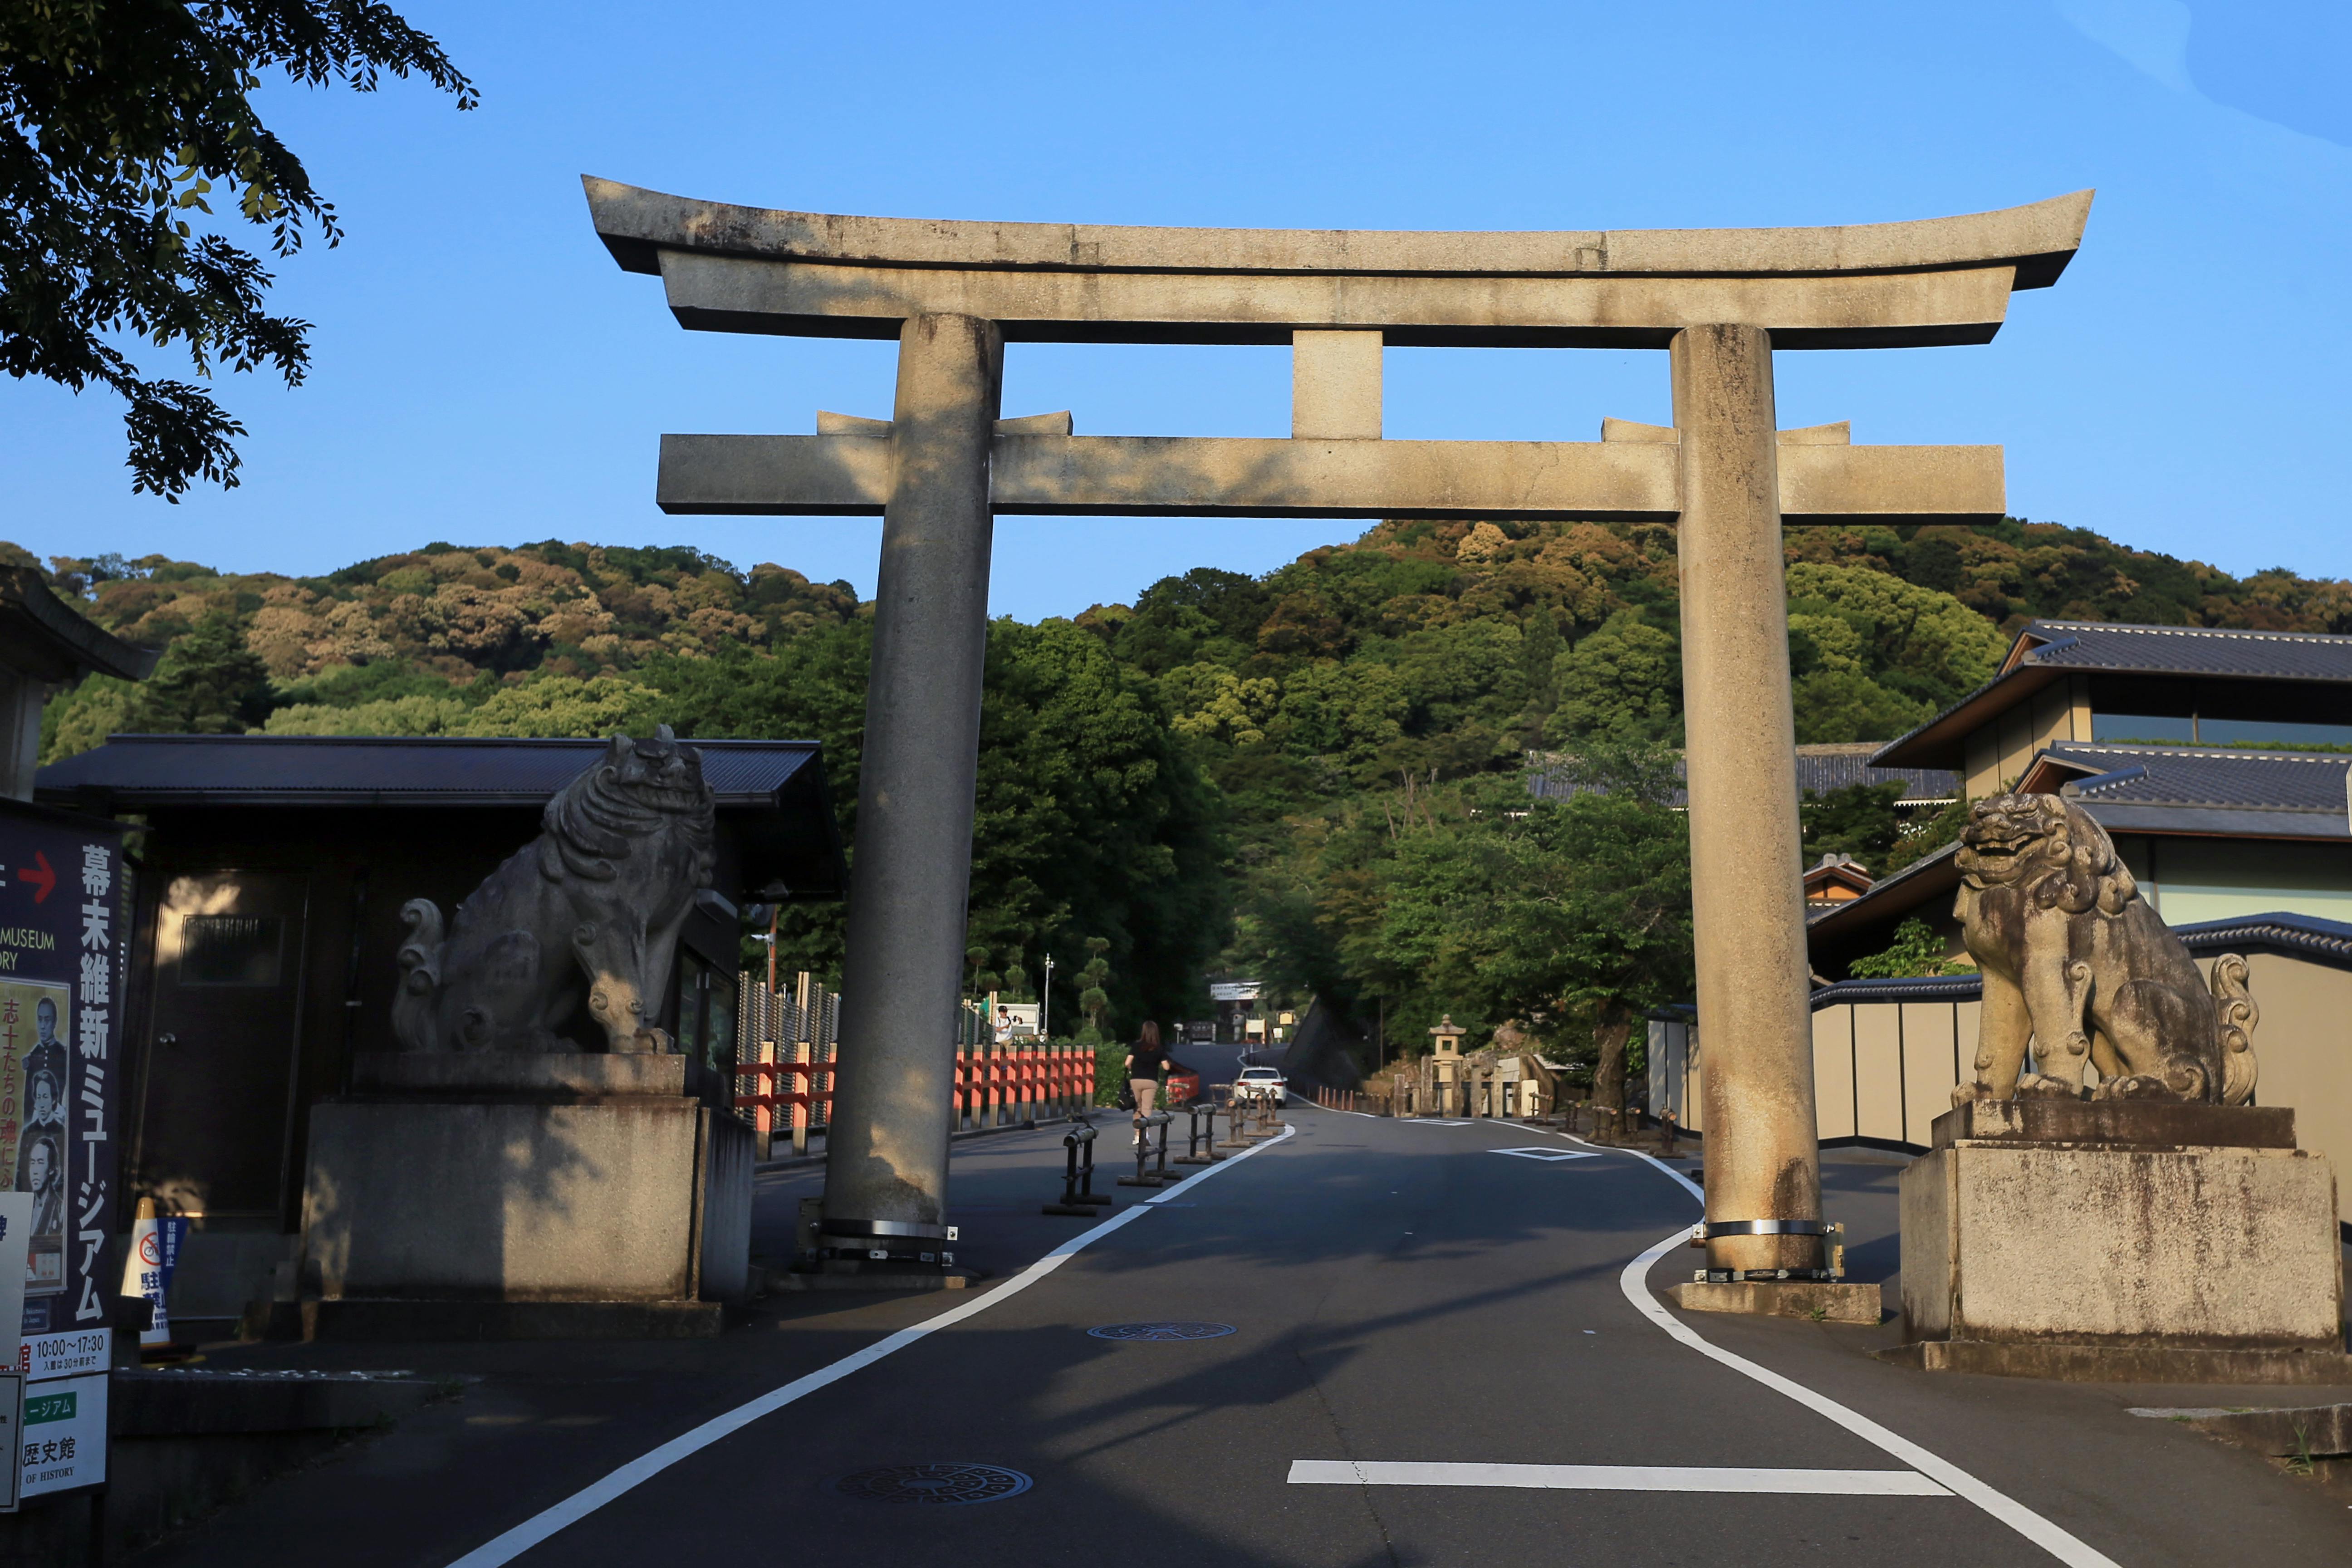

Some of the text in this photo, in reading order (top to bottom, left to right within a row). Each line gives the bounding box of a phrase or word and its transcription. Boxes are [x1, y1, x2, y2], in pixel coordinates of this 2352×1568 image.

[0, 927, 54, 951] MUSEUM
[76, 844, 111, 1321] 幕末維新ミュージアム
[24, 1399, 71, 1419] ージアム
[23, 1436, 76, 1467] 歴史館
[26, 1466, 75, 1484] OF HISTORY
